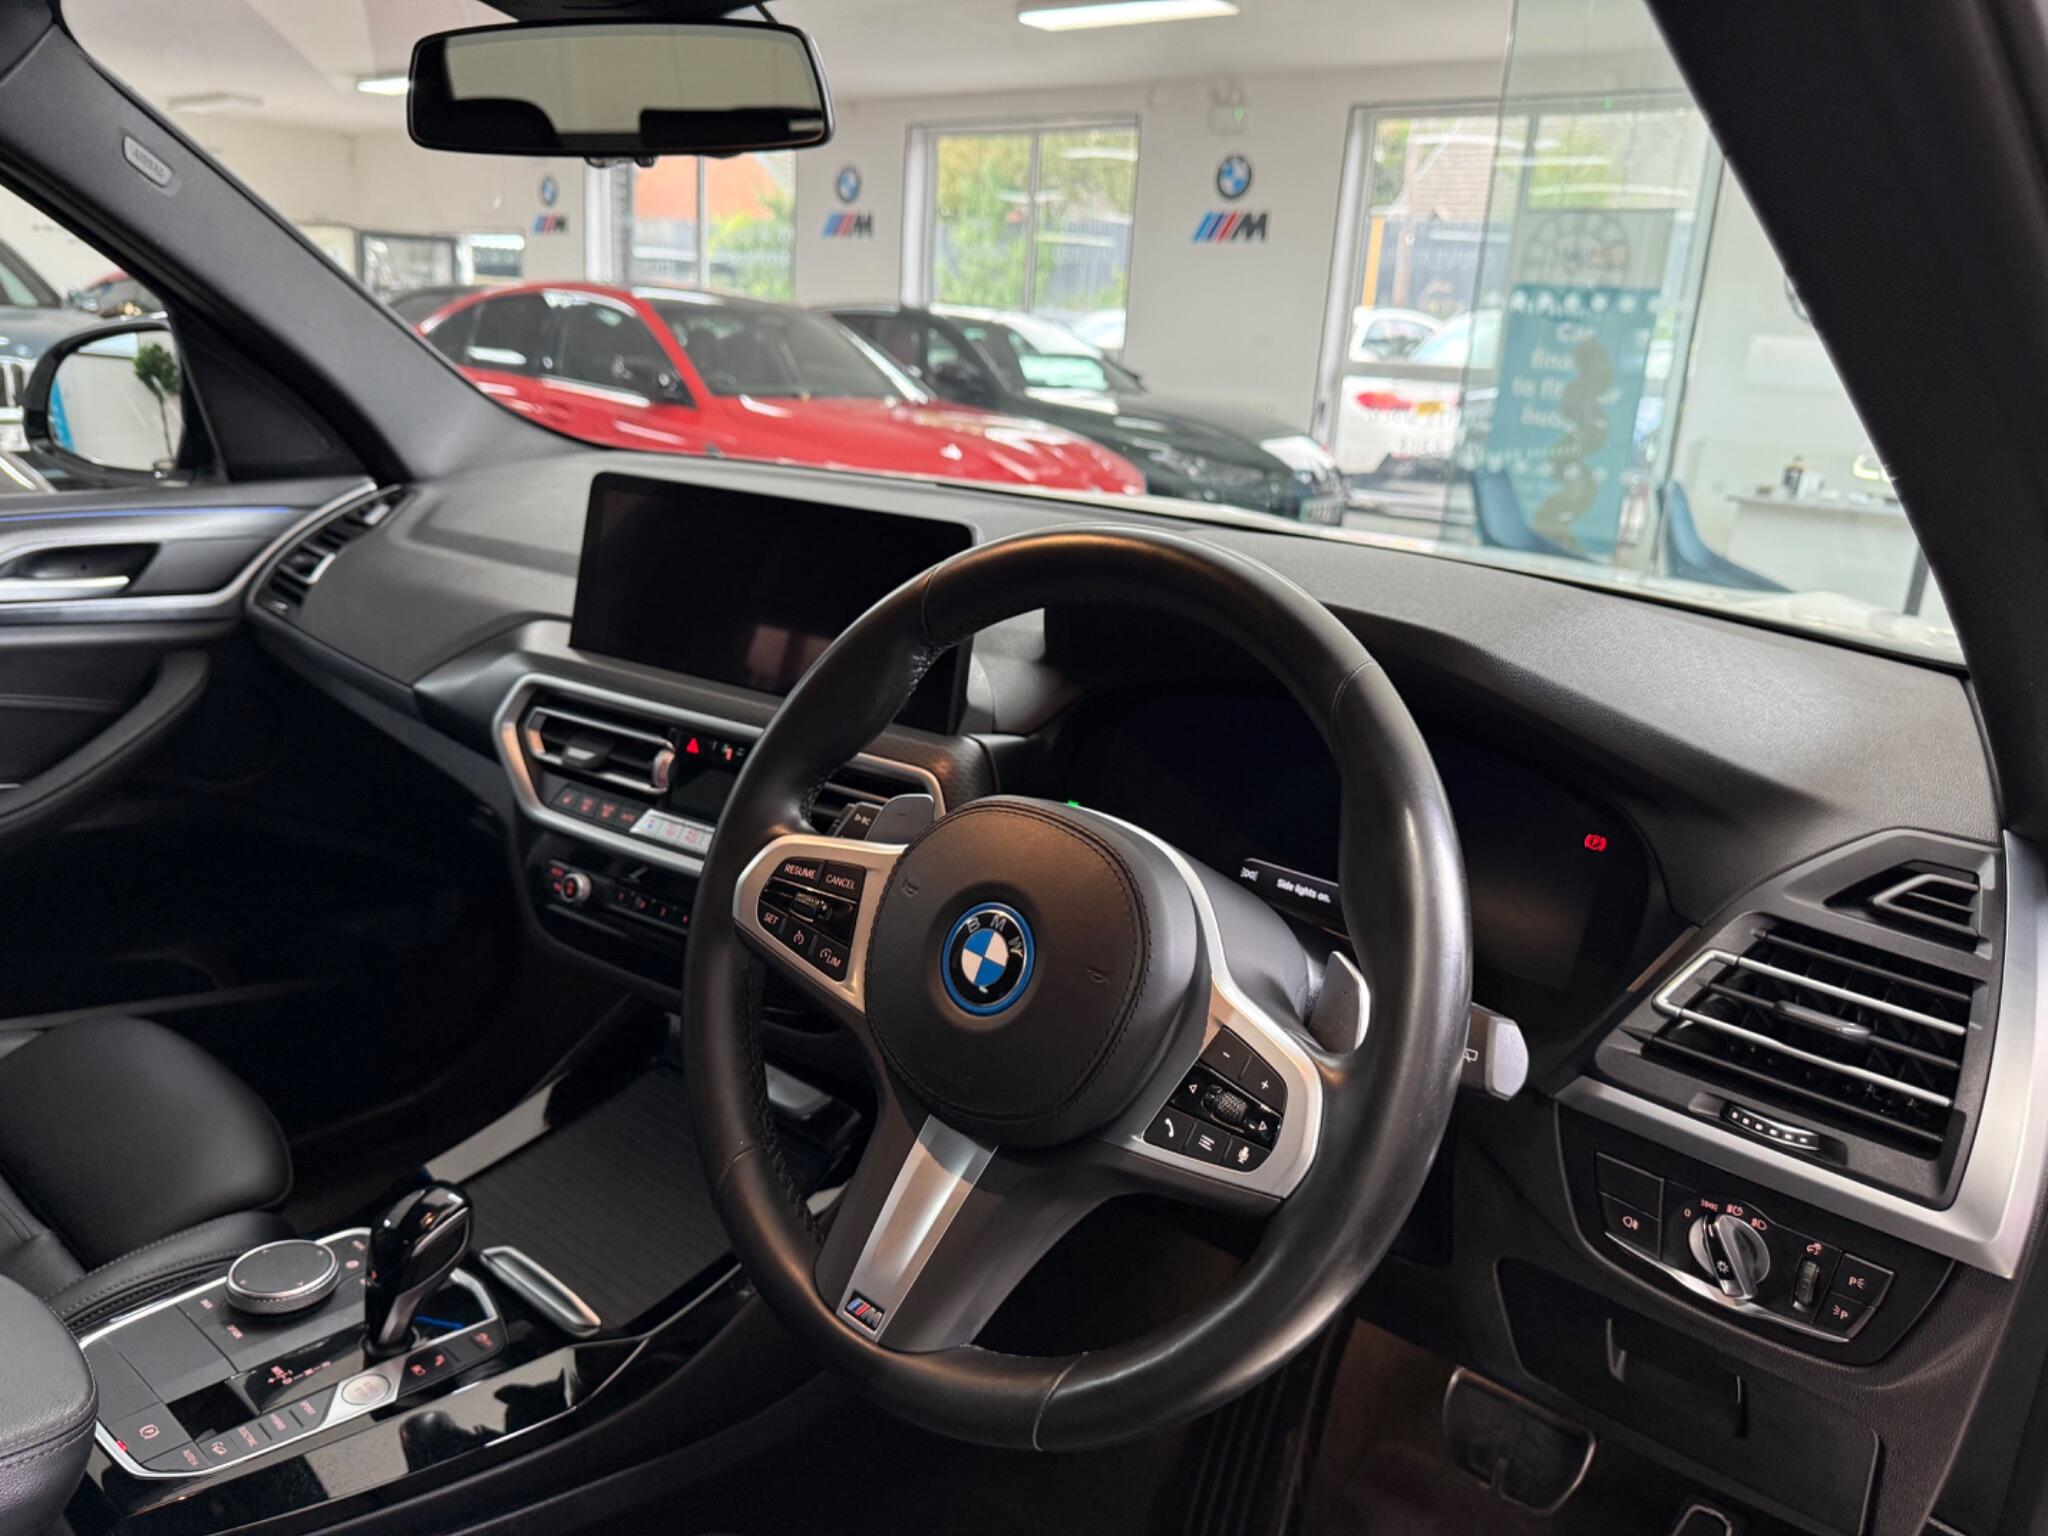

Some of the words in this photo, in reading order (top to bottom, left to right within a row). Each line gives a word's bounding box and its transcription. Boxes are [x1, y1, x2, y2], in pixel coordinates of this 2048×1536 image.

[784, 863, 817, 880] RESUME
[826, 874, 855, 890] CANCEL
[1277, 878, 1294, 892] Side
[1294, 884, 1317, 899] lights
[763, 911, 779, 925] SET
[965, 914, 1024, 958] BMW
